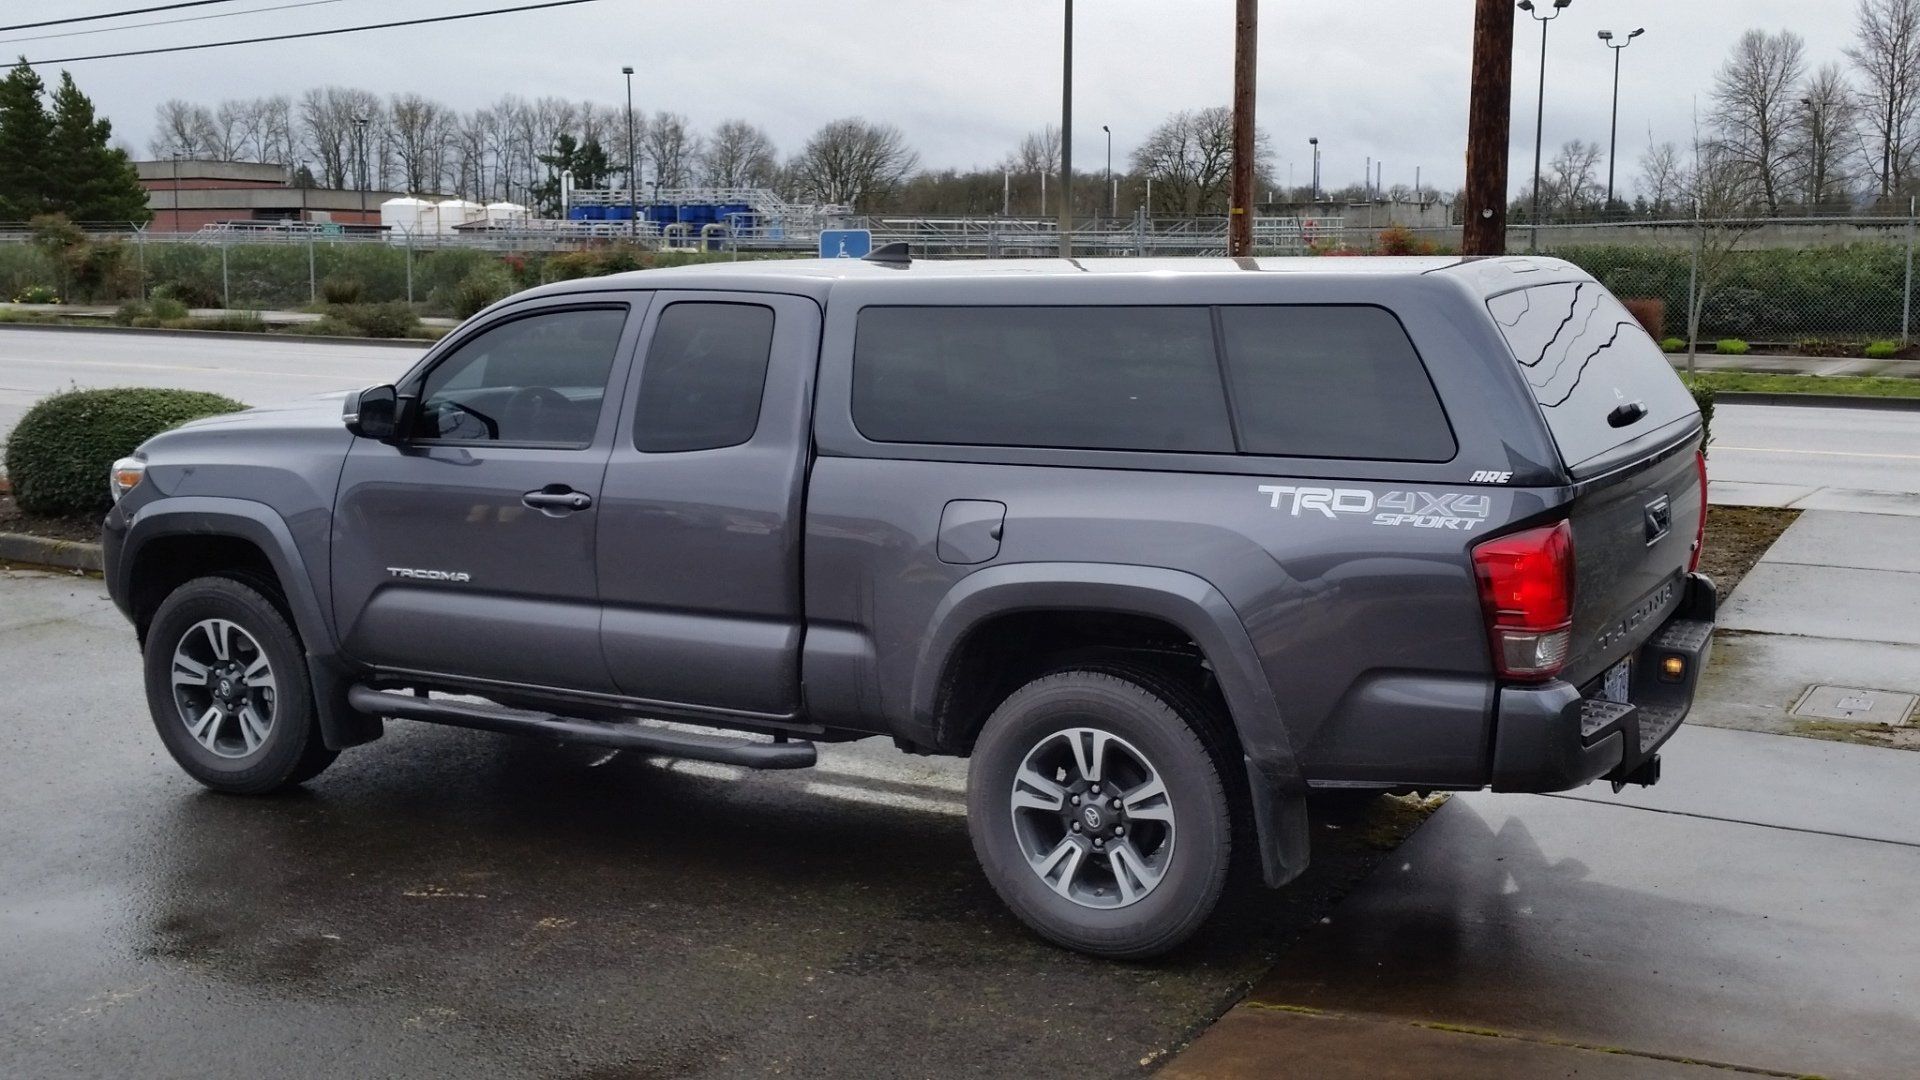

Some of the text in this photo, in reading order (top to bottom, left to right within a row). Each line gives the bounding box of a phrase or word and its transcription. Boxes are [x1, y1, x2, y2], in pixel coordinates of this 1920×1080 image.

[1469, 470, 1513, 483] ARE
[1258, 485, 1375, 520] TRD
[1372, 513, 1485, 530] SPORT
[386, 566, 470, 582] TACOMA
[1598, 582, 1673, 650] TACOMA
